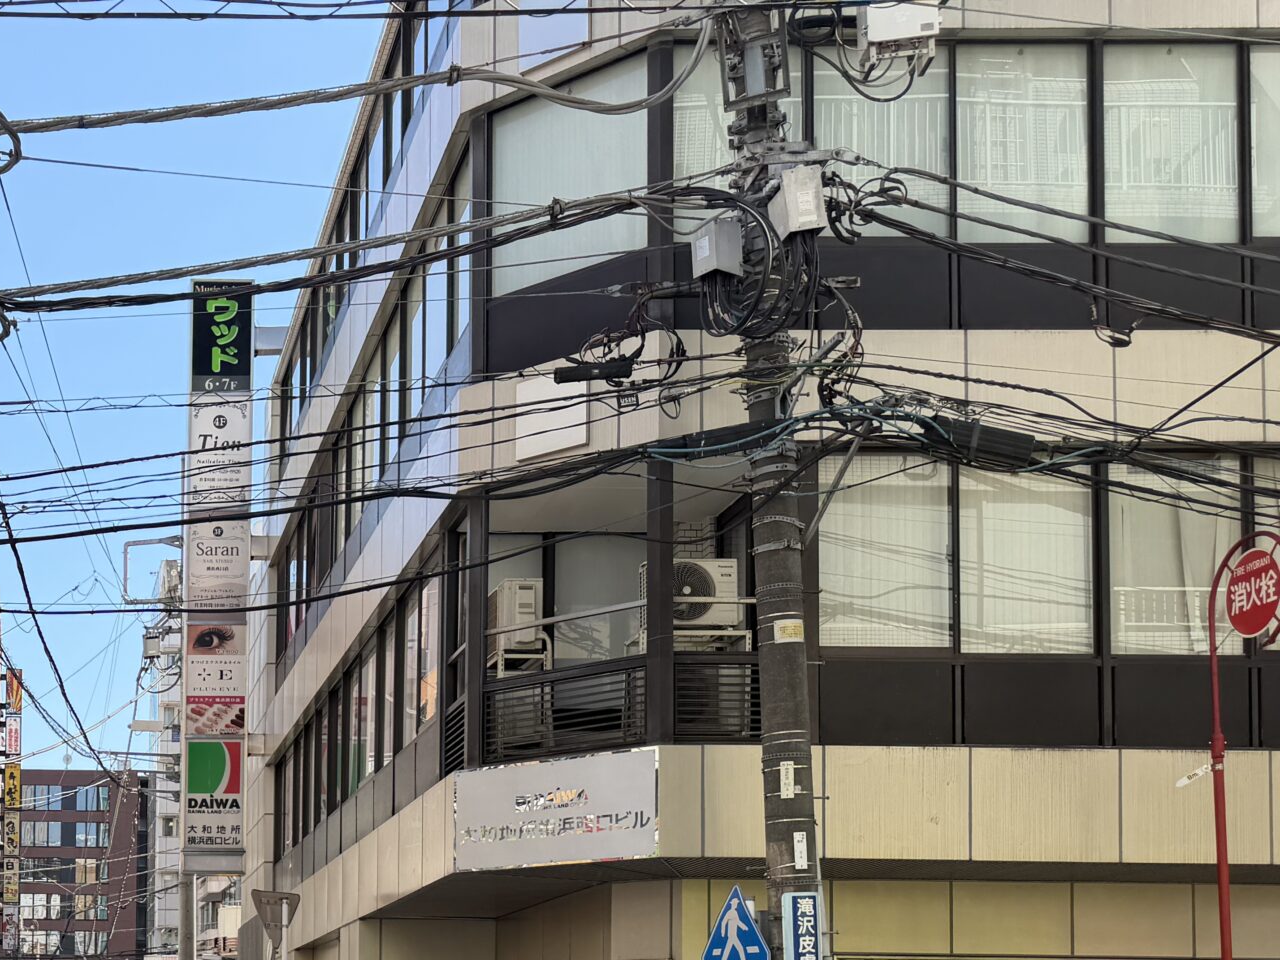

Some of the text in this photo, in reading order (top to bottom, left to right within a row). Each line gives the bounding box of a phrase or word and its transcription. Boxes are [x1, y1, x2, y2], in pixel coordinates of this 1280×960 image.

[206, 297, 239, 373] ウッド
[196, 542, 240, 556] Saran
[1233, 555, 1271, 578] FIRE HYDRANT
[1230, 569, 1278, 616] 消火栓
[188, 825, 241, 835] 大和地所
[188, 836, 240, 845] 横浜西口ビル
